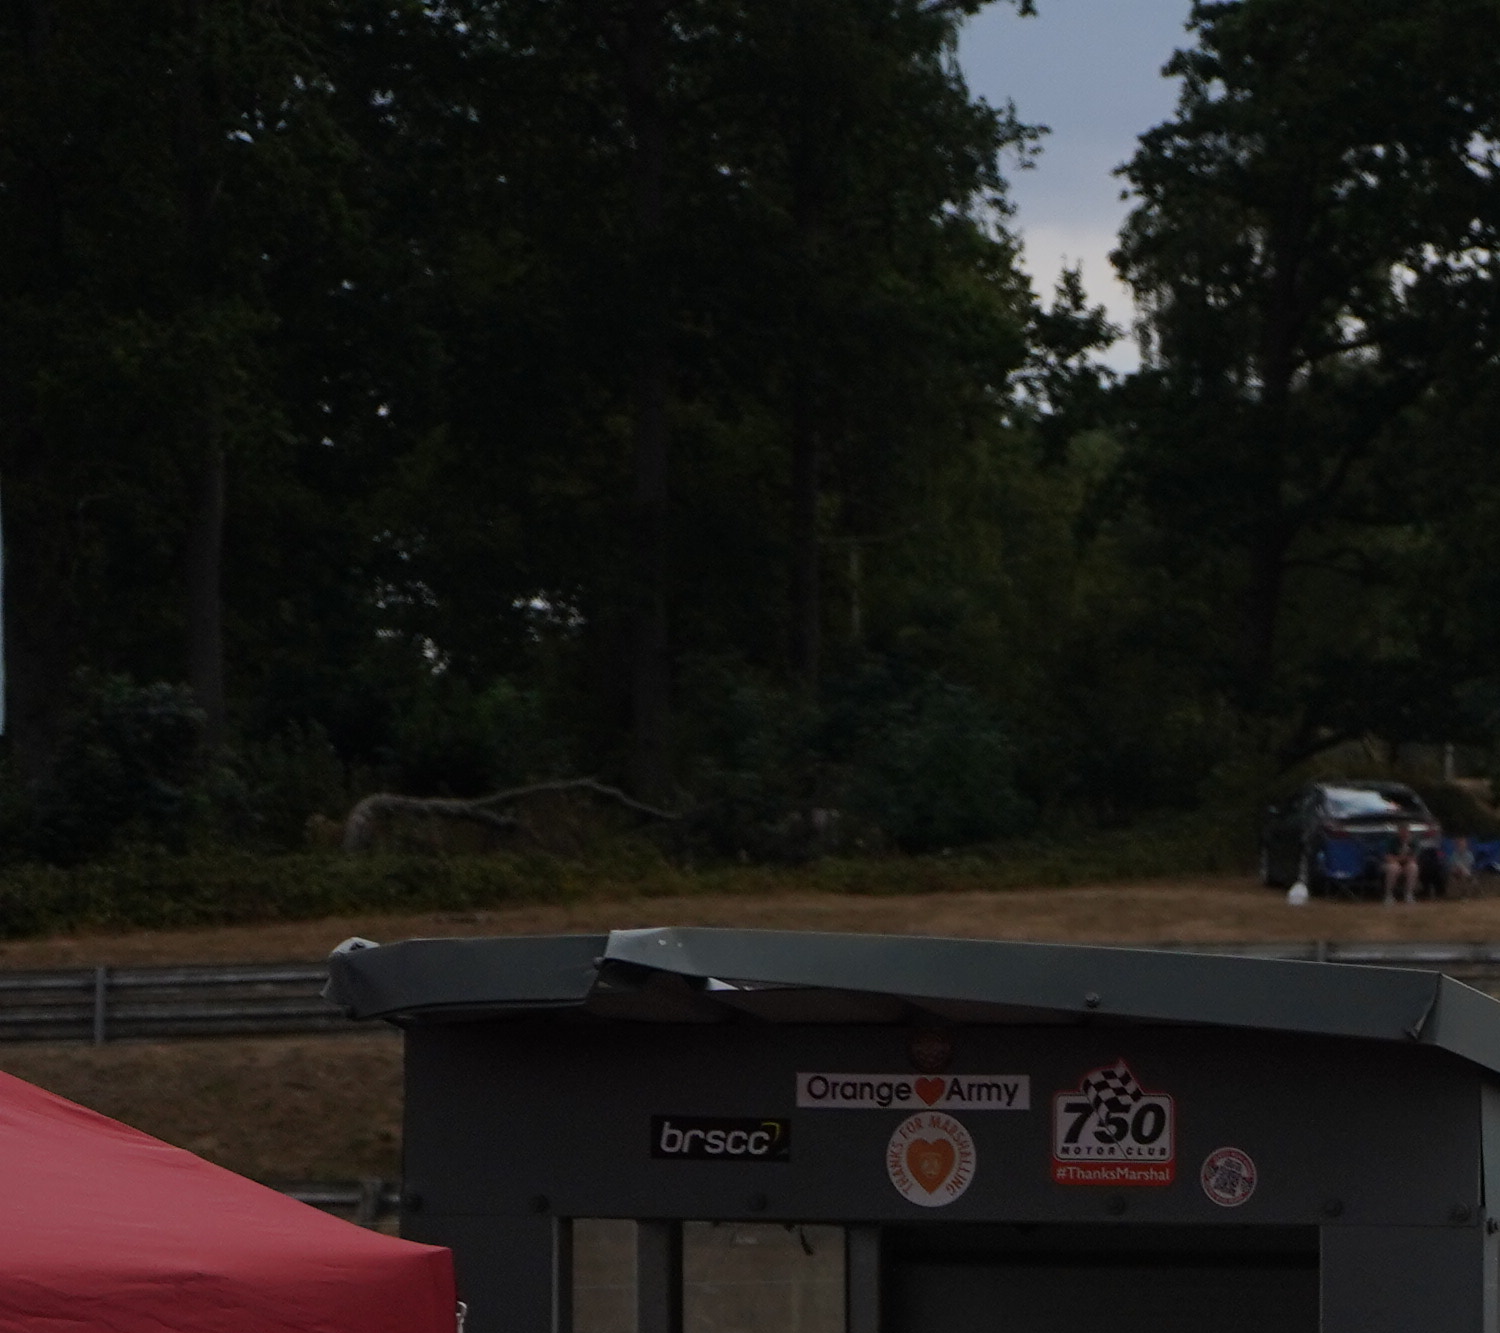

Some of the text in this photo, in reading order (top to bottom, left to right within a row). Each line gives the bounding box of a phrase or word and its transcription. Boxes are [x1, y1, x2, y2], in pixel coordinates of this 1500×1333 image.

[807, 1075, 1019, 1107] Orange Army
[660, 1121, 769, 1155] brscc
[1064, 1103, 1166, 1144] 750
[889, 1115, 972, 1196] THANKS FOR MARSHALLING
[1061, 1146, 1167, 1155] MOTOR CLUB
[1056, 1166, 1170, 1180] #ThanksMarshal
